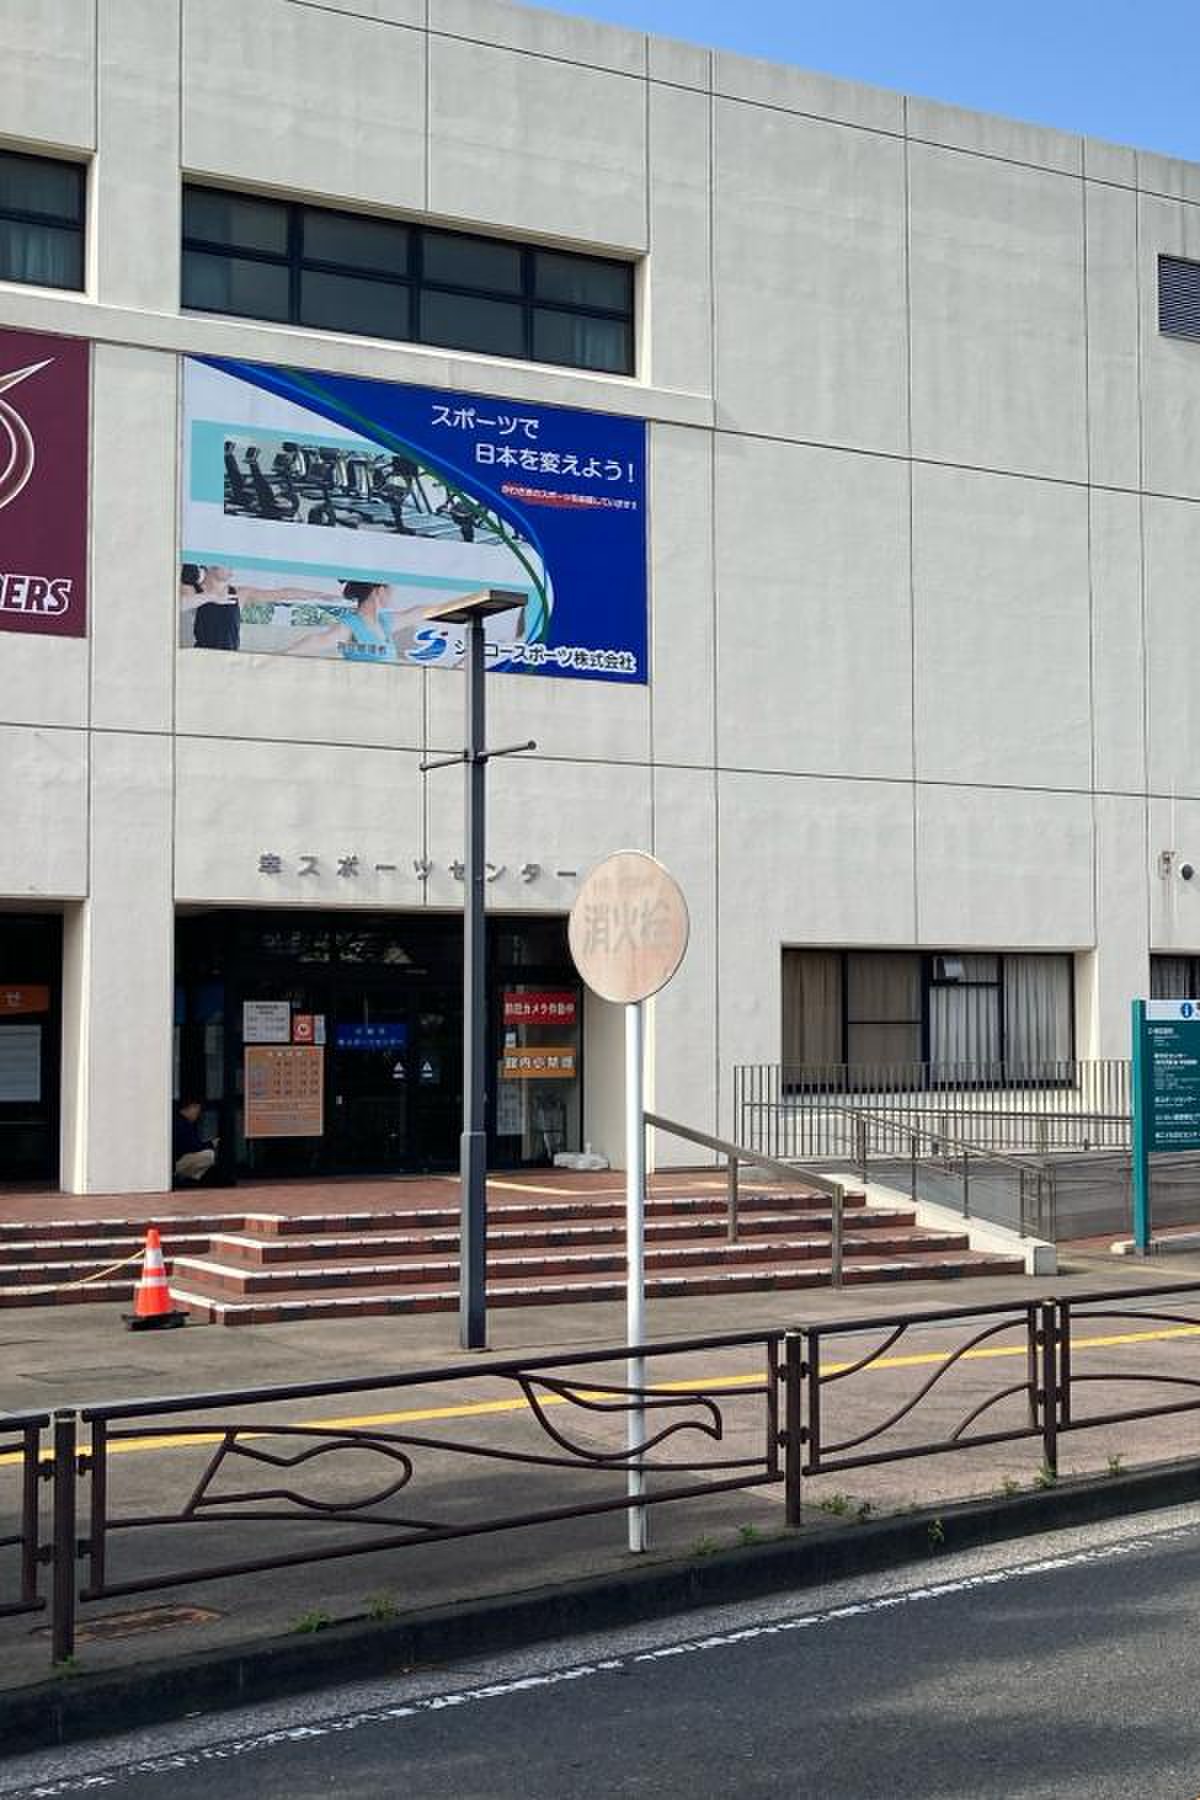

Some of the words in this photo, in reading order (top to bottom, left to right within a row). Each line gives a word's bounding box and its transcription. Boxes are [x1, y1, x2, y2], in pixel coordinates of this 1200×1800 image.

[431, 404, 540, 439] スポーツで
[475, 442, 635, 484] 日本を変えよう！
[0, 573, 73, 615] ERS
[454, 637, 637, 672] シコースポーツ株式会社
[257, 852, 577, 884] 幸スポーツセンター
